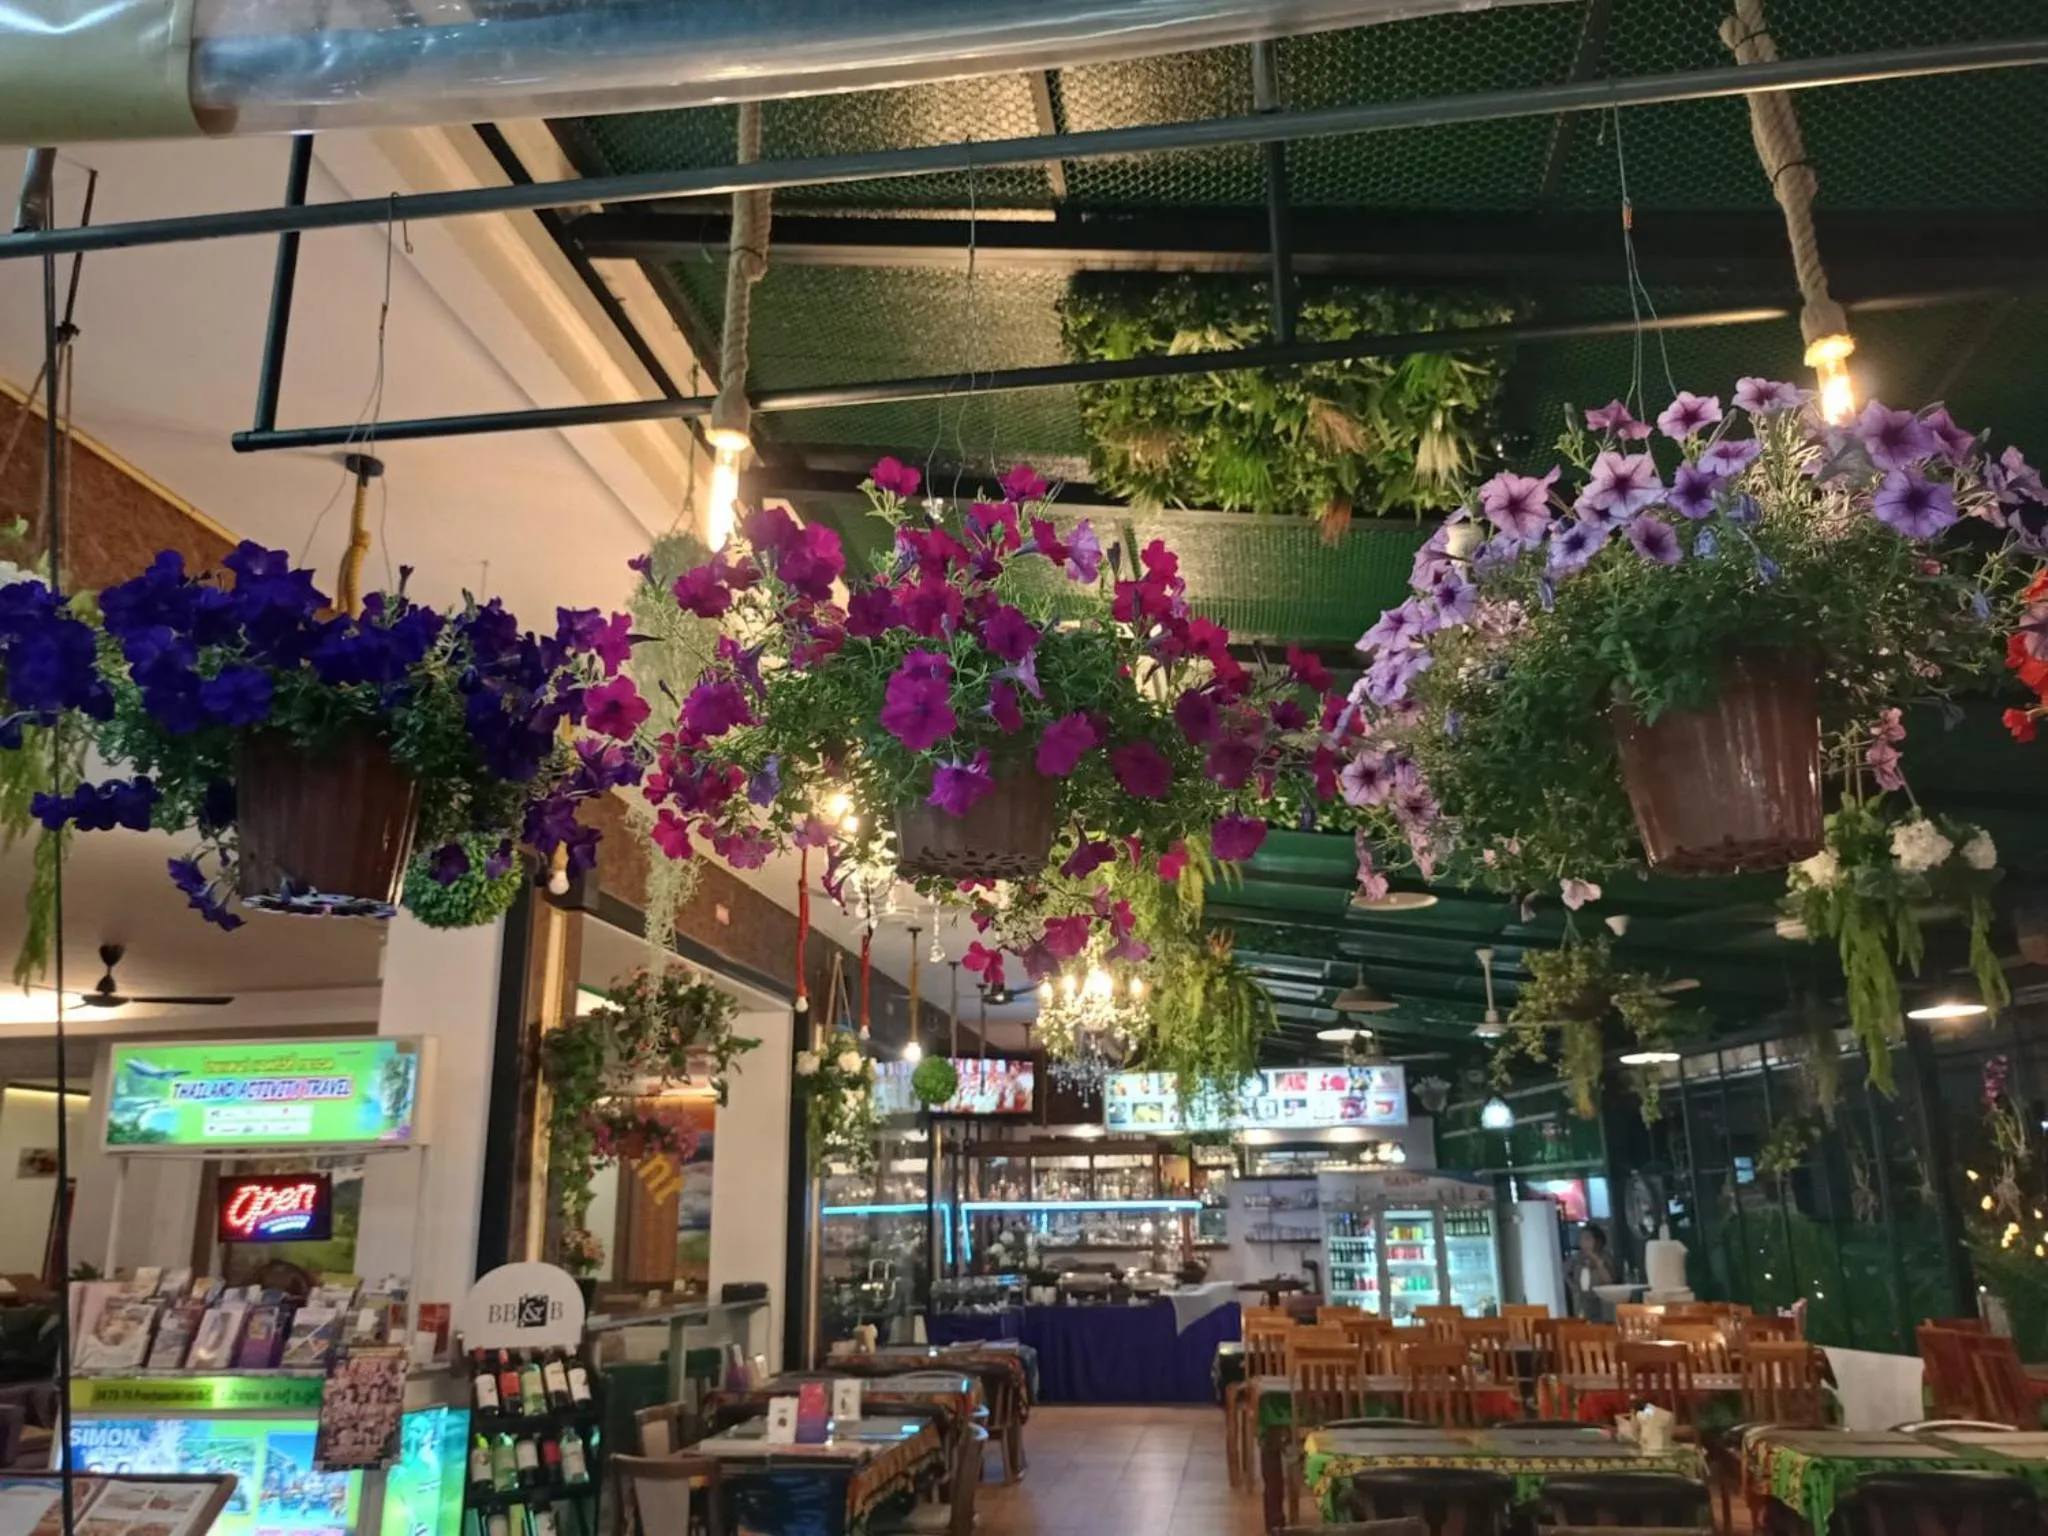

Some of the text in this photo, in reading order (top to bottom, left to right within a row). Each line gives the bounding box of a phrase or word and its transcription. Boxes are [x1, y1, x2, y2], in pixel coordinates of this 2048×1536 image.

[173, 1078, 351, 1100] THAILAND ACTIVITY TRAVEL
[226, 1184, 317, 1235] Open
[70, 1427, 141, 1446] SIMON
